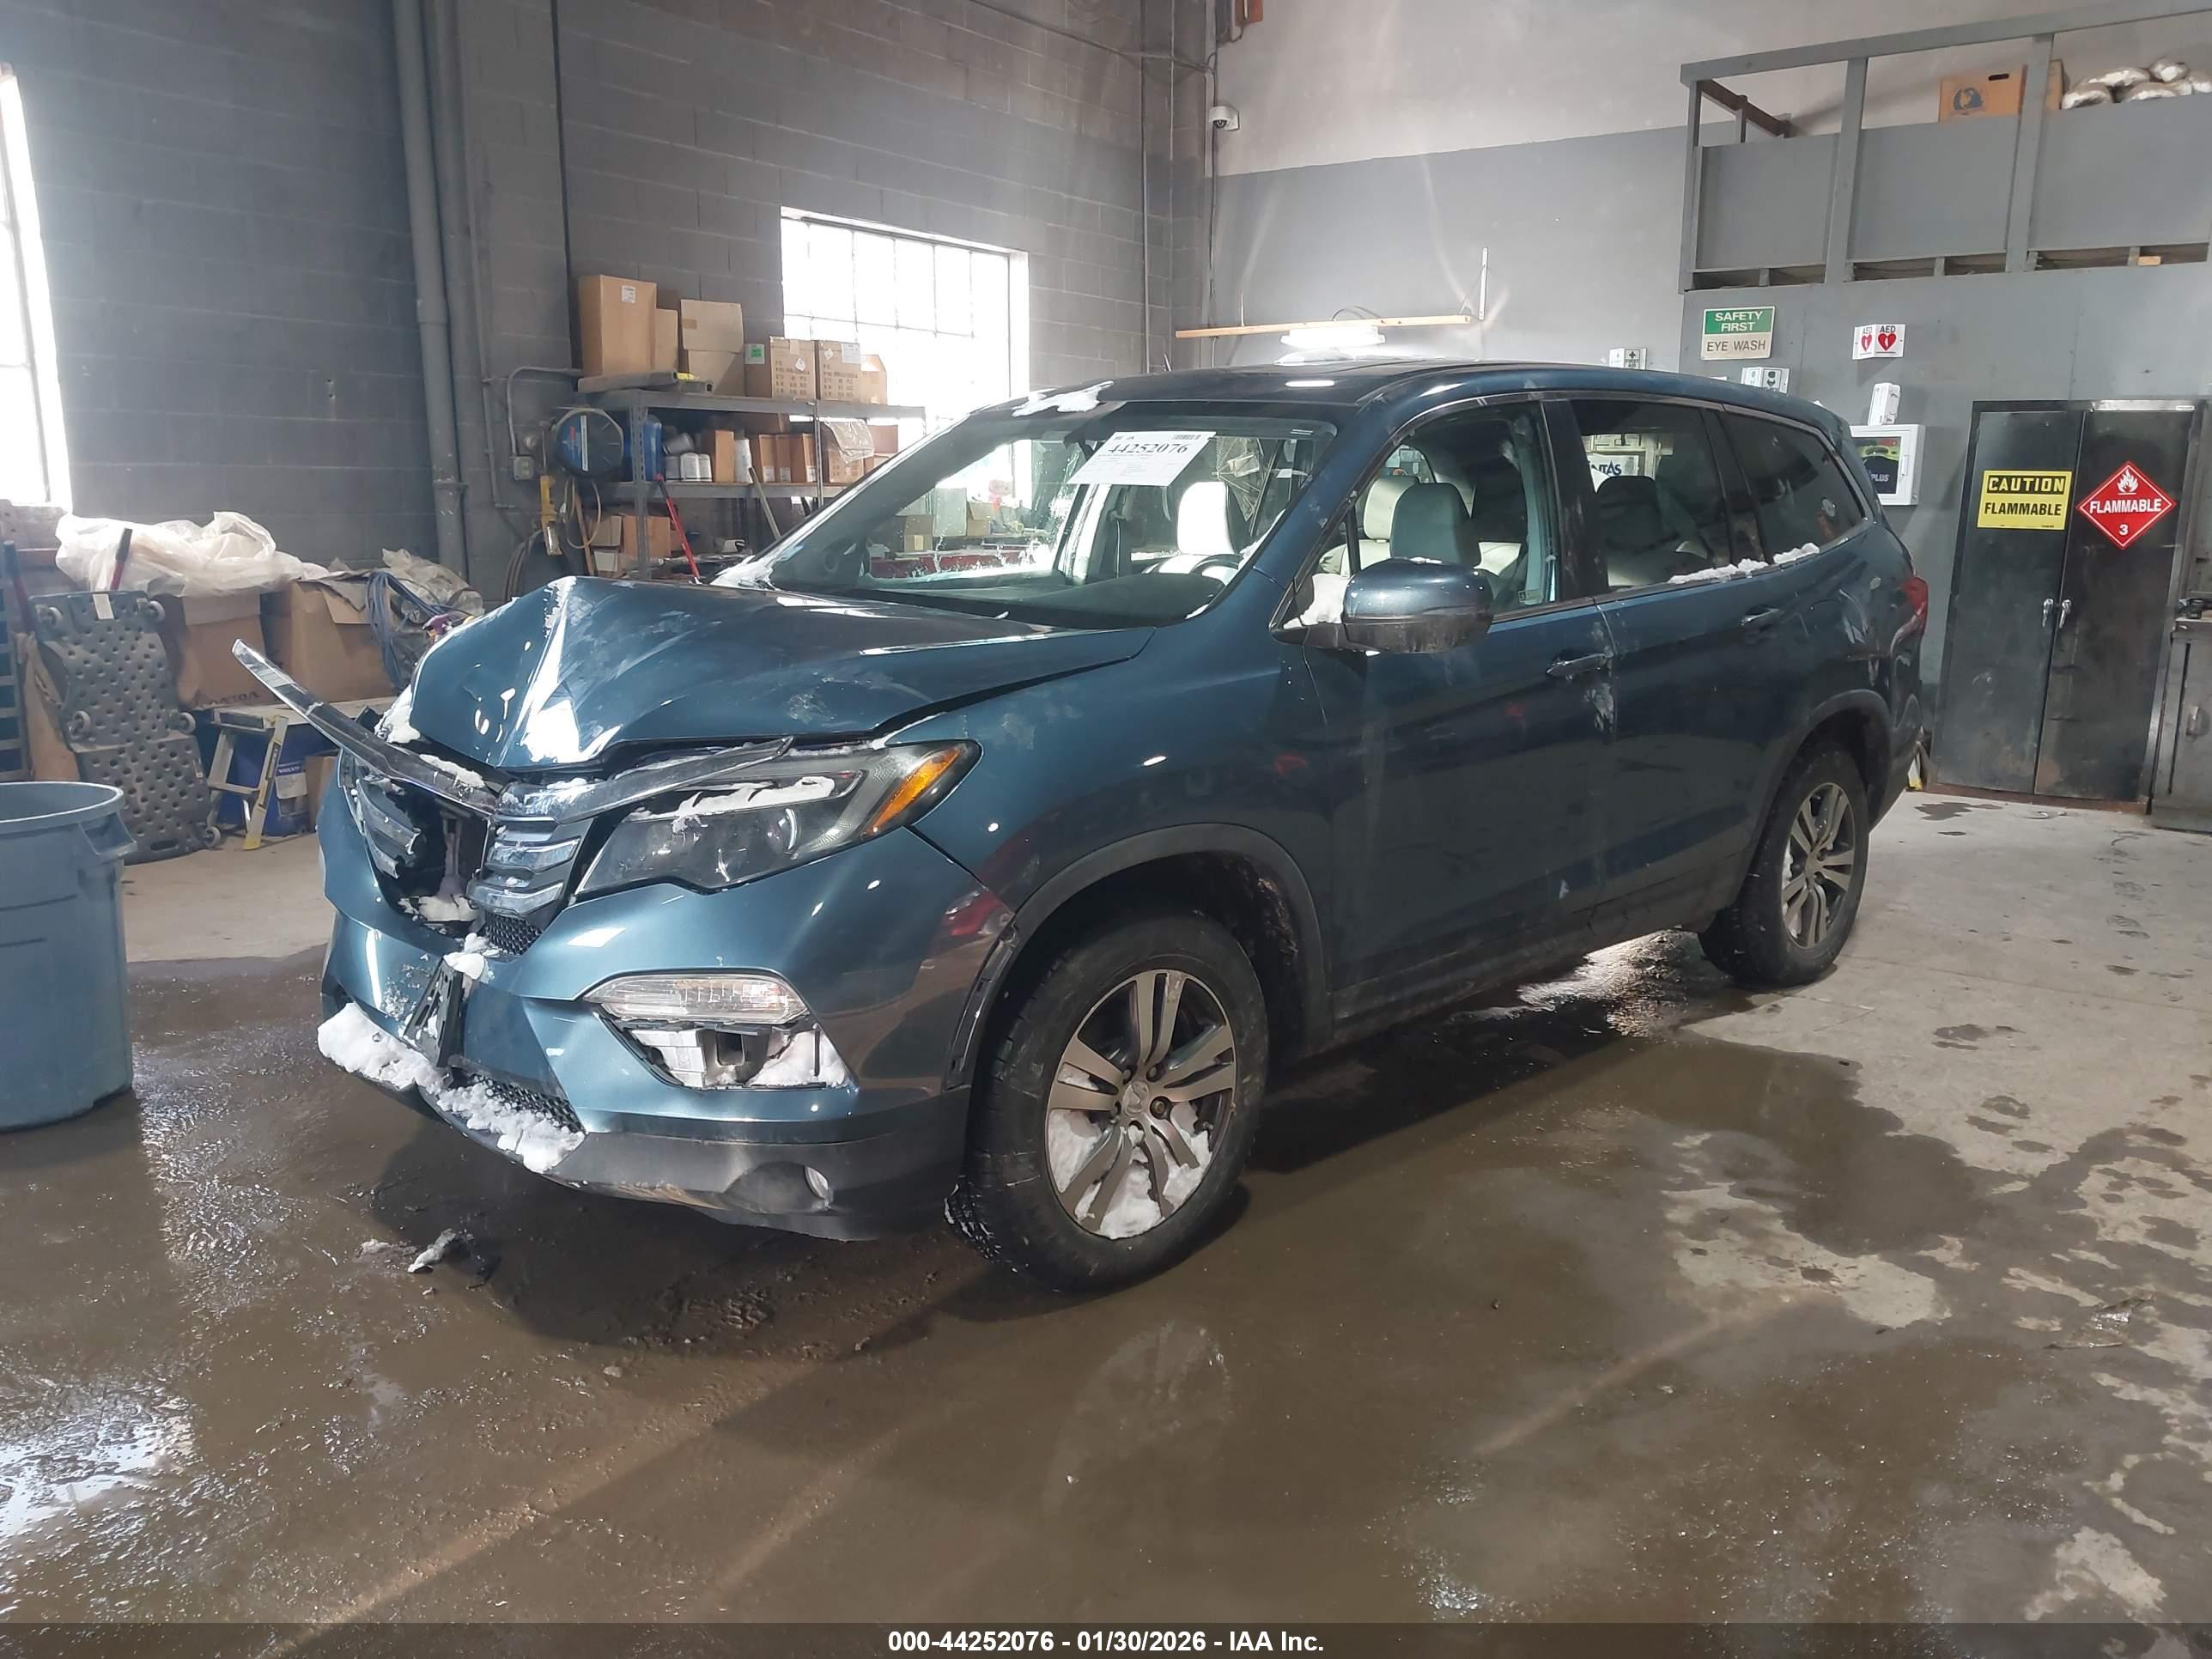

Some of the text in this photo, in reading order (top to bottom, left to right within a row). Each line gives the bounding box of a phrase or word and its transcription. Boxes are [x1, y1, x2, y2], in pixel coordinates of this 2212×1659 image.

[1715, 311, 1763, 321] SAFETY
[1721, 322, 1755, 332] FIRST
[1706, 340, 1765, 352] EYE WASH
[1109, 443, 1189, 453] 44252076
[1870, 473, 1890, 483] PLUS
[1988, 477, 2064, 492] CAUTION
[1984, 502, 2062, 516] FLAMMABLE
[2089, 498, 2162, 514] FLAMMABLE
[2118, 524, 2129, 536] 3
